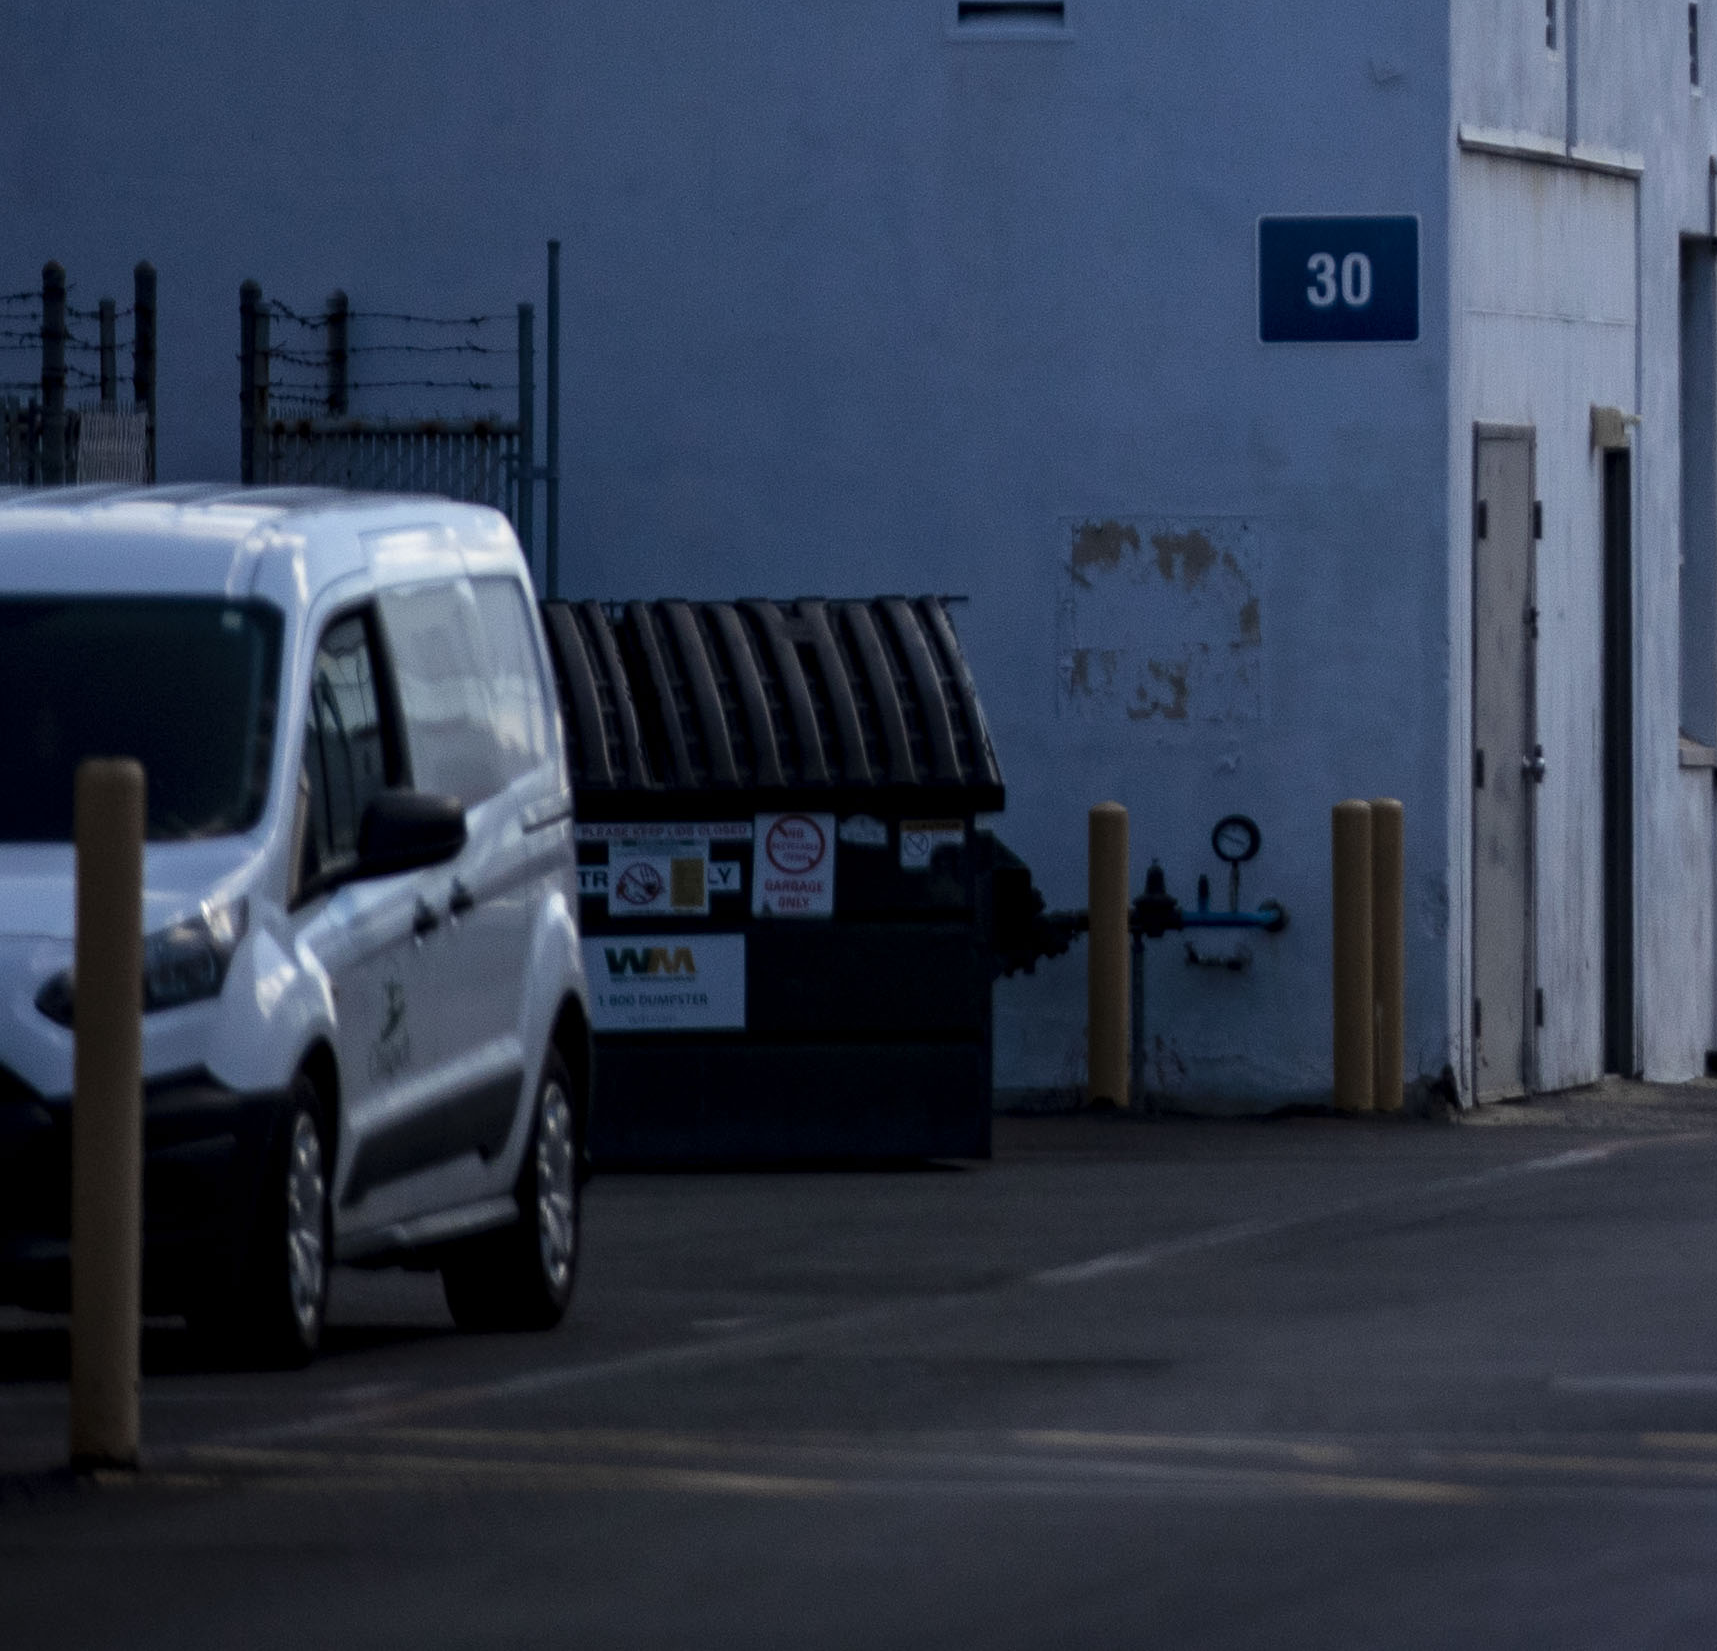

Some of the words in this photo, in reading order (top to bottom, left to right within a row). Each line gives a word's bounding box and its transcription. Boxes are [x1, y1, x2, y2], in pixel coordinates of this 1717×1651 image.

[1307, 252, 1372, 308] 30
[582, 824, 630, 838] PLEASE
[633, 823, 663, 837] KEEP
[667, 822, 695, 837] LIDS
[700, 821, 748, 836] CLOSED
[707, 867, 732, 884] LY
[764, 879, 824, 895] GARBAGE
[778, 896, 810, 910] ONLY
[605, 947, 696, 975] WM
[609, 994, 635, 1007] 800
[638, 993, 708, 1007] DUMPSTER
